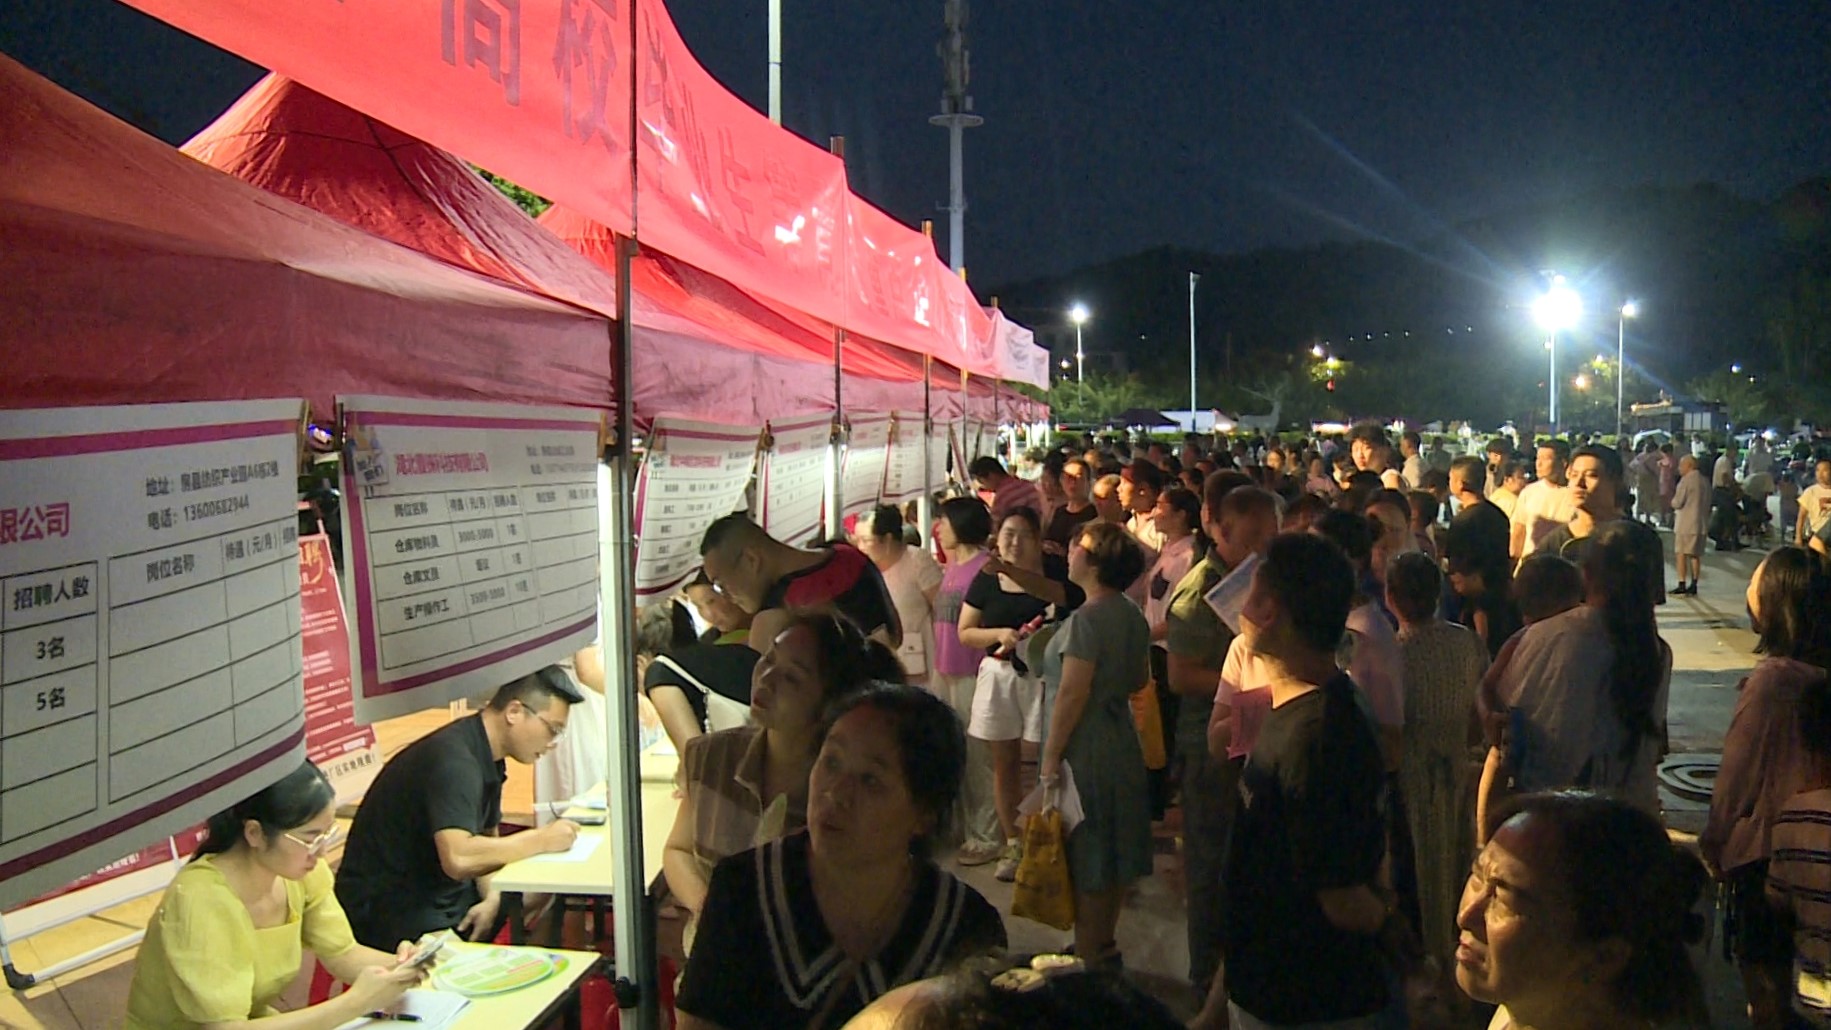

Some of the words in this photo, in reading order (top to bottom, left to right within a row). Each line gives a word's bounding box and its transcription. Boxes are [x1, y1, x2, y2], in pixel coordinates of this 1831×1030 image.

[146, 554, 195, 583] 岗位名称
[403, 567, 440, 587] 仓库文员
[13, 575, 90, 611] 招聘人数
[403, 599, 450, 622] 生产操作工
[36, 637, 65, 660] 3名
[36, 687, 65, 711] 5名
